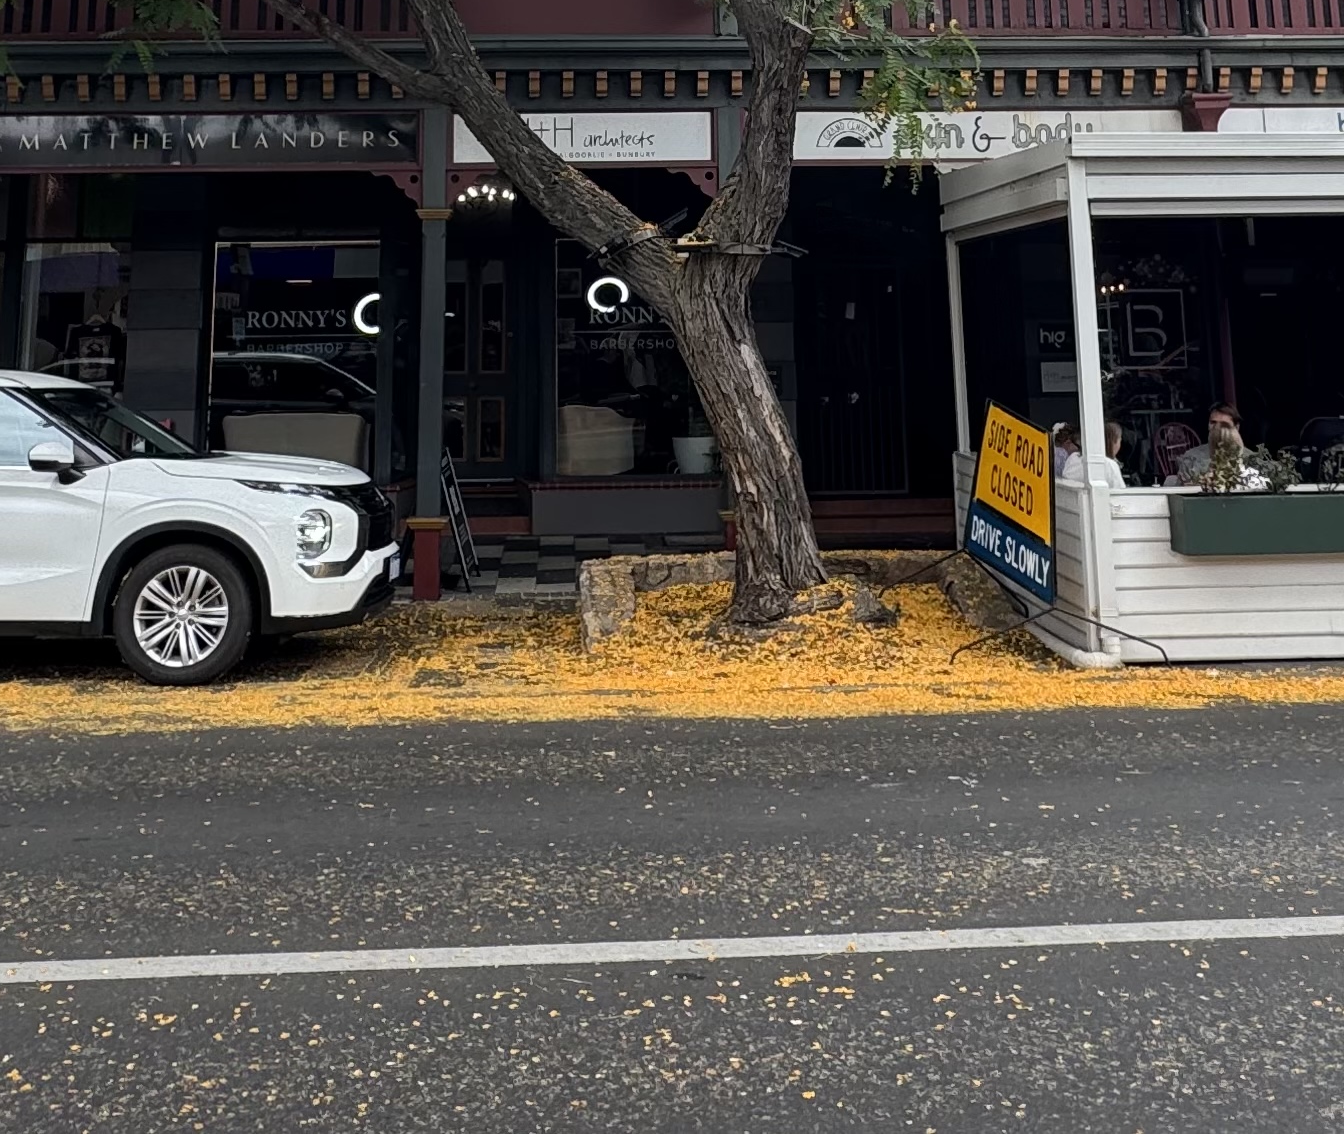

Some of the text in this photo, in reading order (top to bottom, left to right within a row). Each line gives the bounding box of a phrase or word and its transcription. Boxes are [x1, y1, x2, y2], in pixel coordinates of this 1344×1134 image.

[18, 129, 400, 151] MATTHEW LANDERS
[582, 130, 655, 149] architects
[972, 115, 1006, 153] &
[1011, 112, 1093, 149] bod
[616, 151, 656, 159] BUNBURY
[246, 308, 348, 329] RONNY'S
[588, 305, 666, 325] RONN
[246, 342, 345, 354] BARBERSHOP
[589, 338, 675, 350] BARBERSHO
[987, 419, 1044, 478] SIDE ROAD
[990, 463, 1034, 516] CLOSED
[971, 514, 1051, 589] DRIVE SLOWLY
